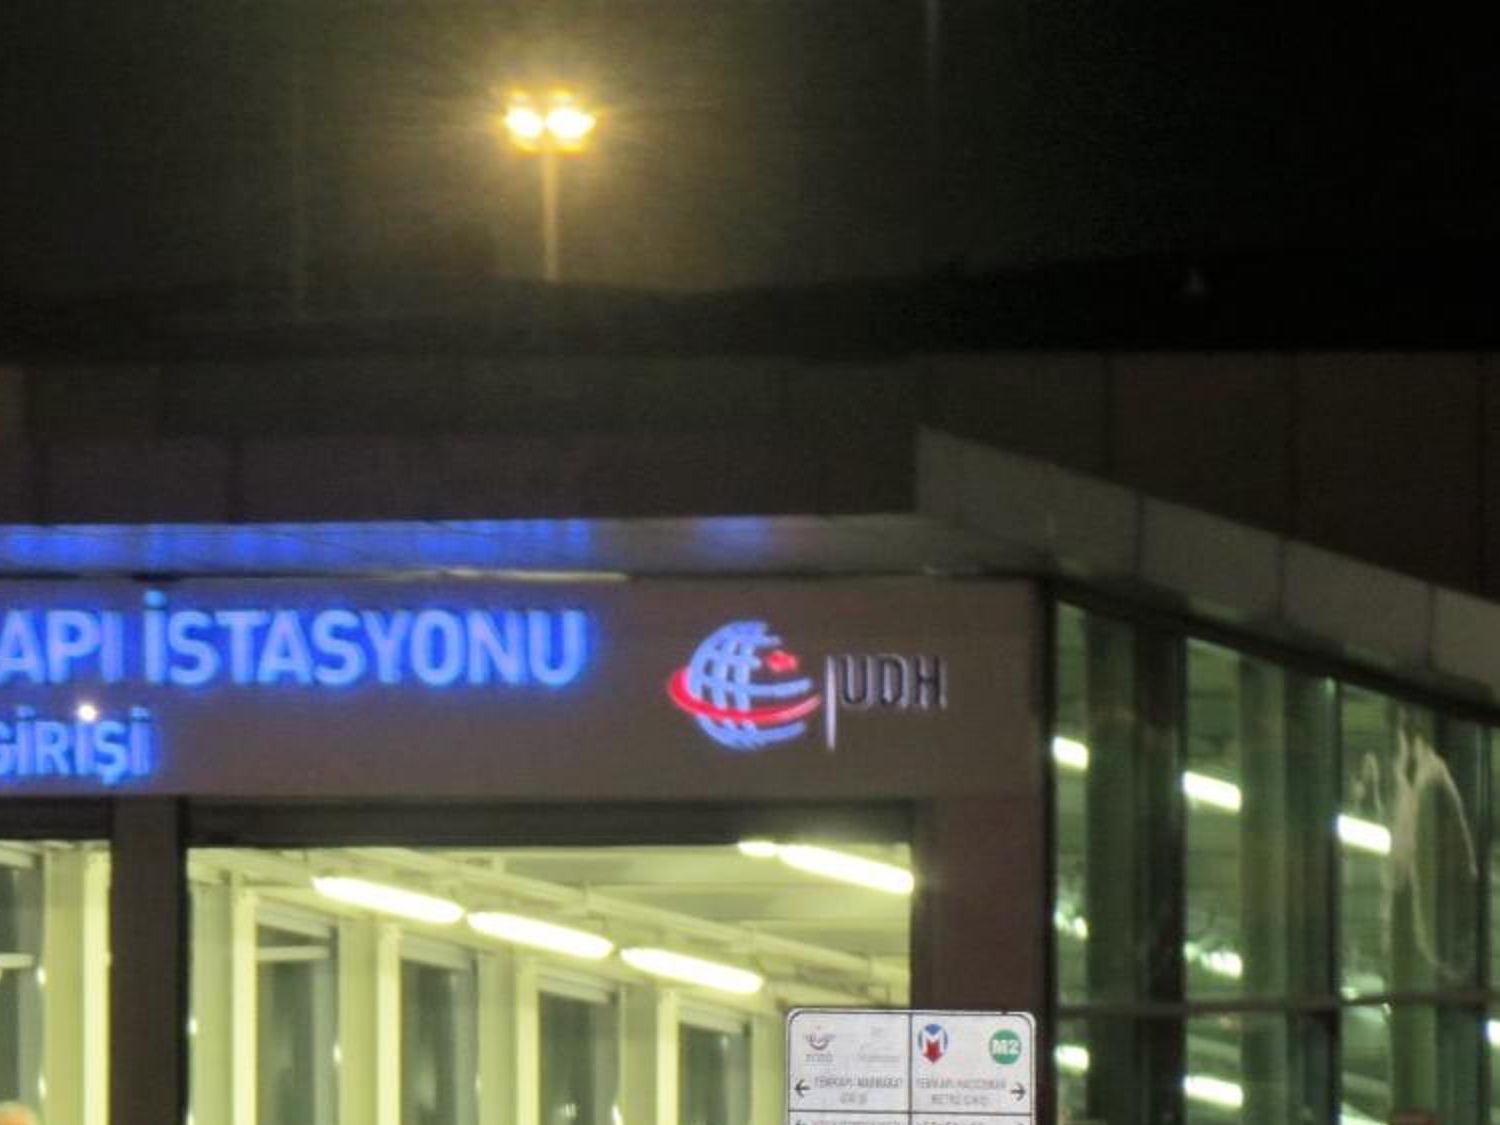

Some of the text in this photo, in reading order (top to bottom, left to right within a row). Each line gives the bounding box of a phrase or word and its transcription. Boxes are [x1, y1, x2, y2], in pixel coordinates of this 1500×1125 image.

[143, 589, 588, 686] İSTASYONU
[841, 653, 949, 708] UDH
[991, 1040, 1021, 1055] M2
